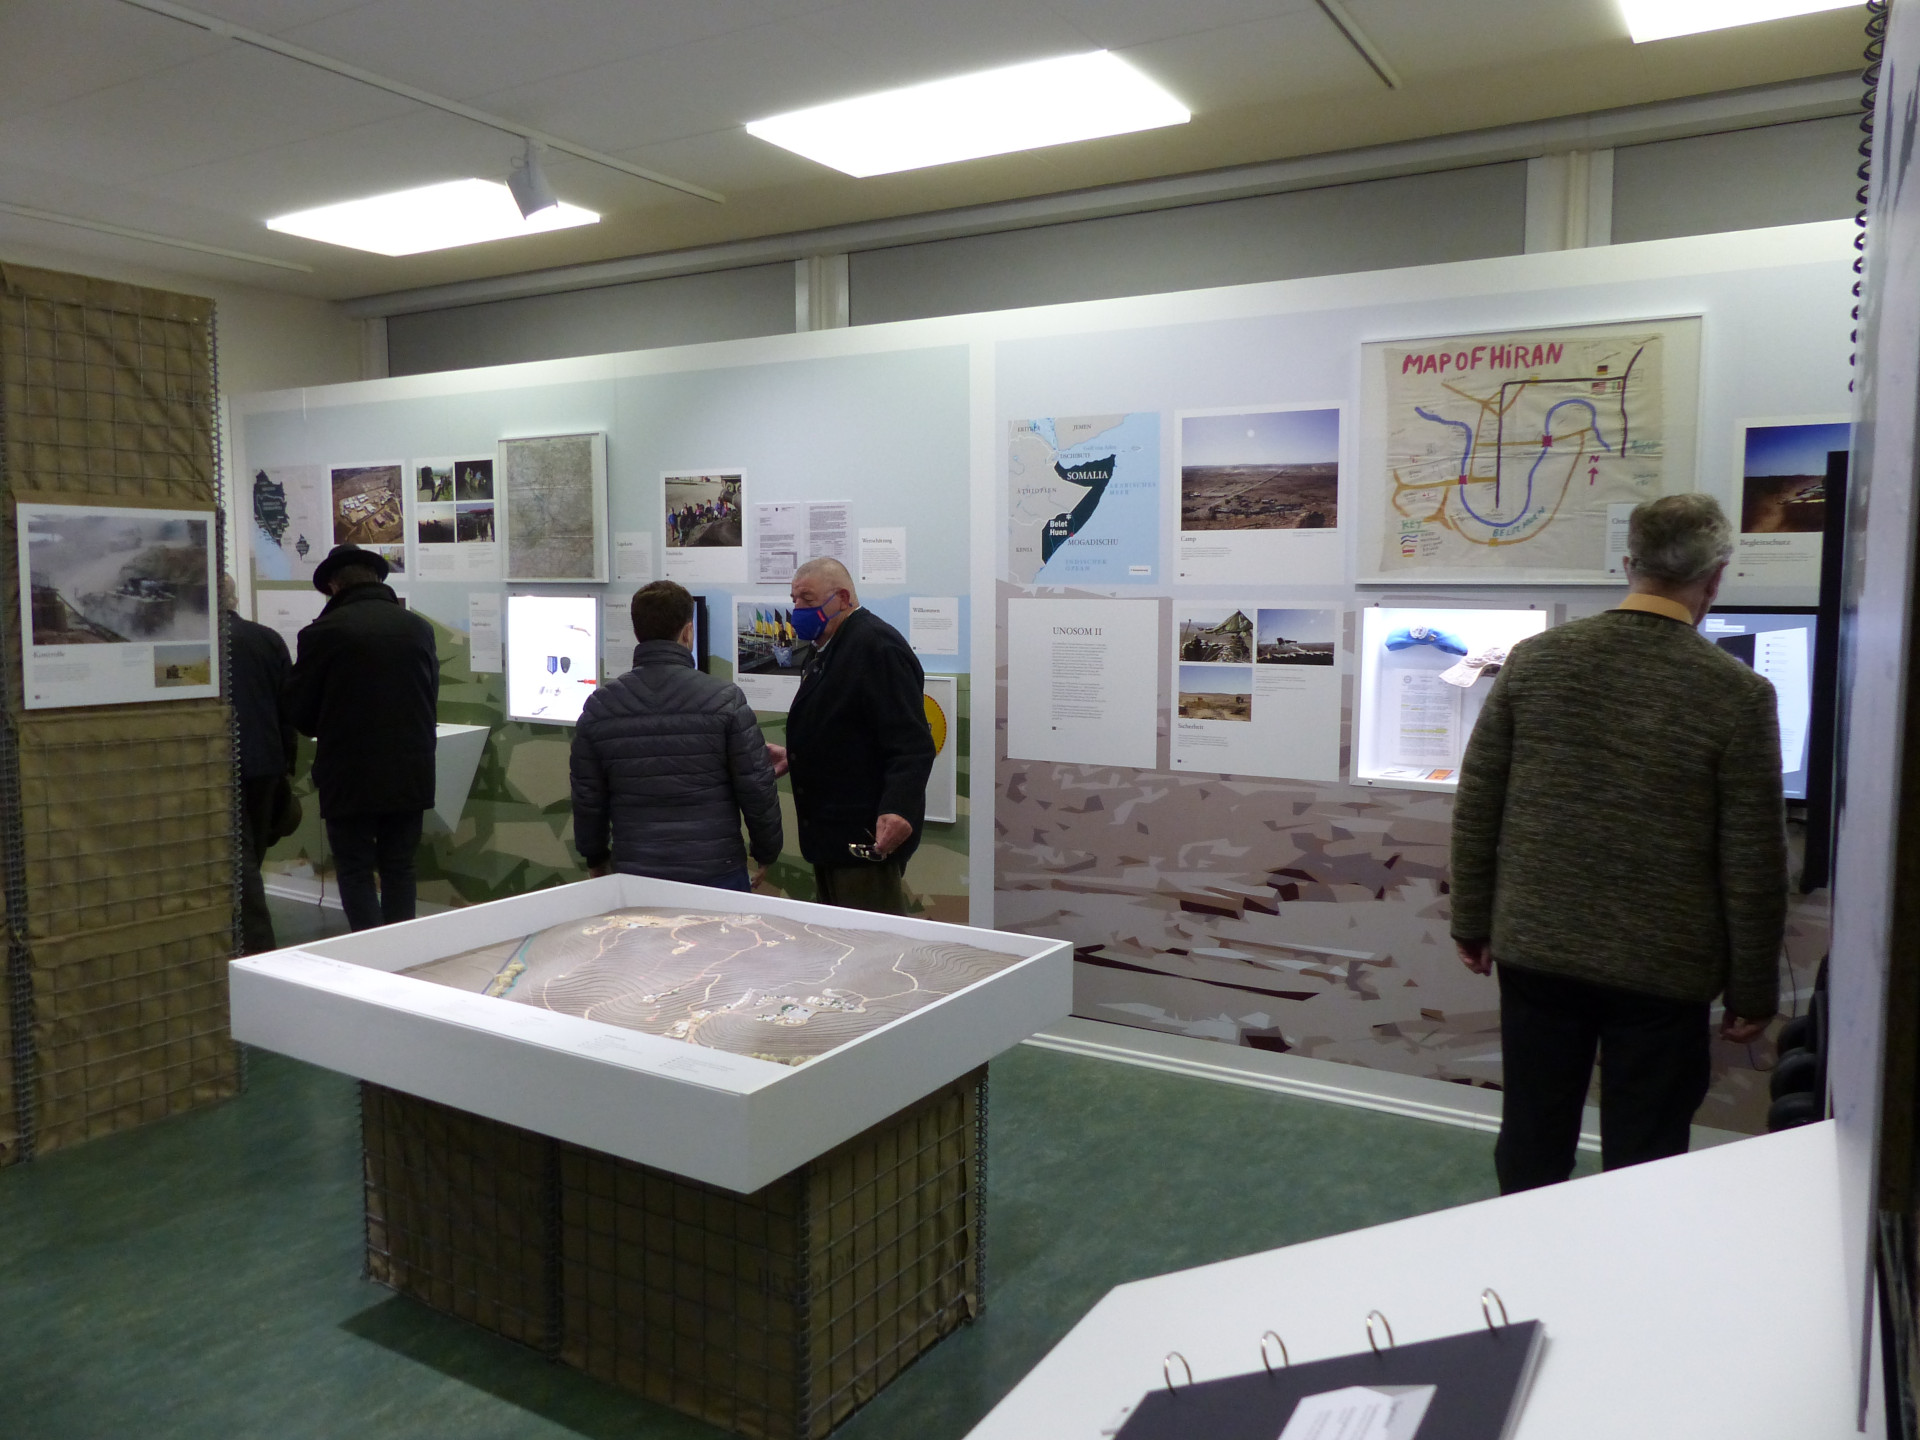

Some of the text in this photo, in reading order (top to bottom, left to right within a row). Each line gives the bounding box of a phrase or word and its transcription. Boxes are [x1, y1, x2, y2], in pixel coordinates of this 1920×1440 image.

[1402, 353, 1451, 374] MAP
[1456, 346, 1487, 371] OF
[1588, 455, 1600, 464] N
[1066, 471, 1109, 480] SOMALIA
[1050, 520, 1068, 528] Belet
[1068, 538, 1119, 546] MOGADISCHU
[1180, 535, 1197, 543] Camp
[1053, 626, 1102, 635] UNOSOM II
